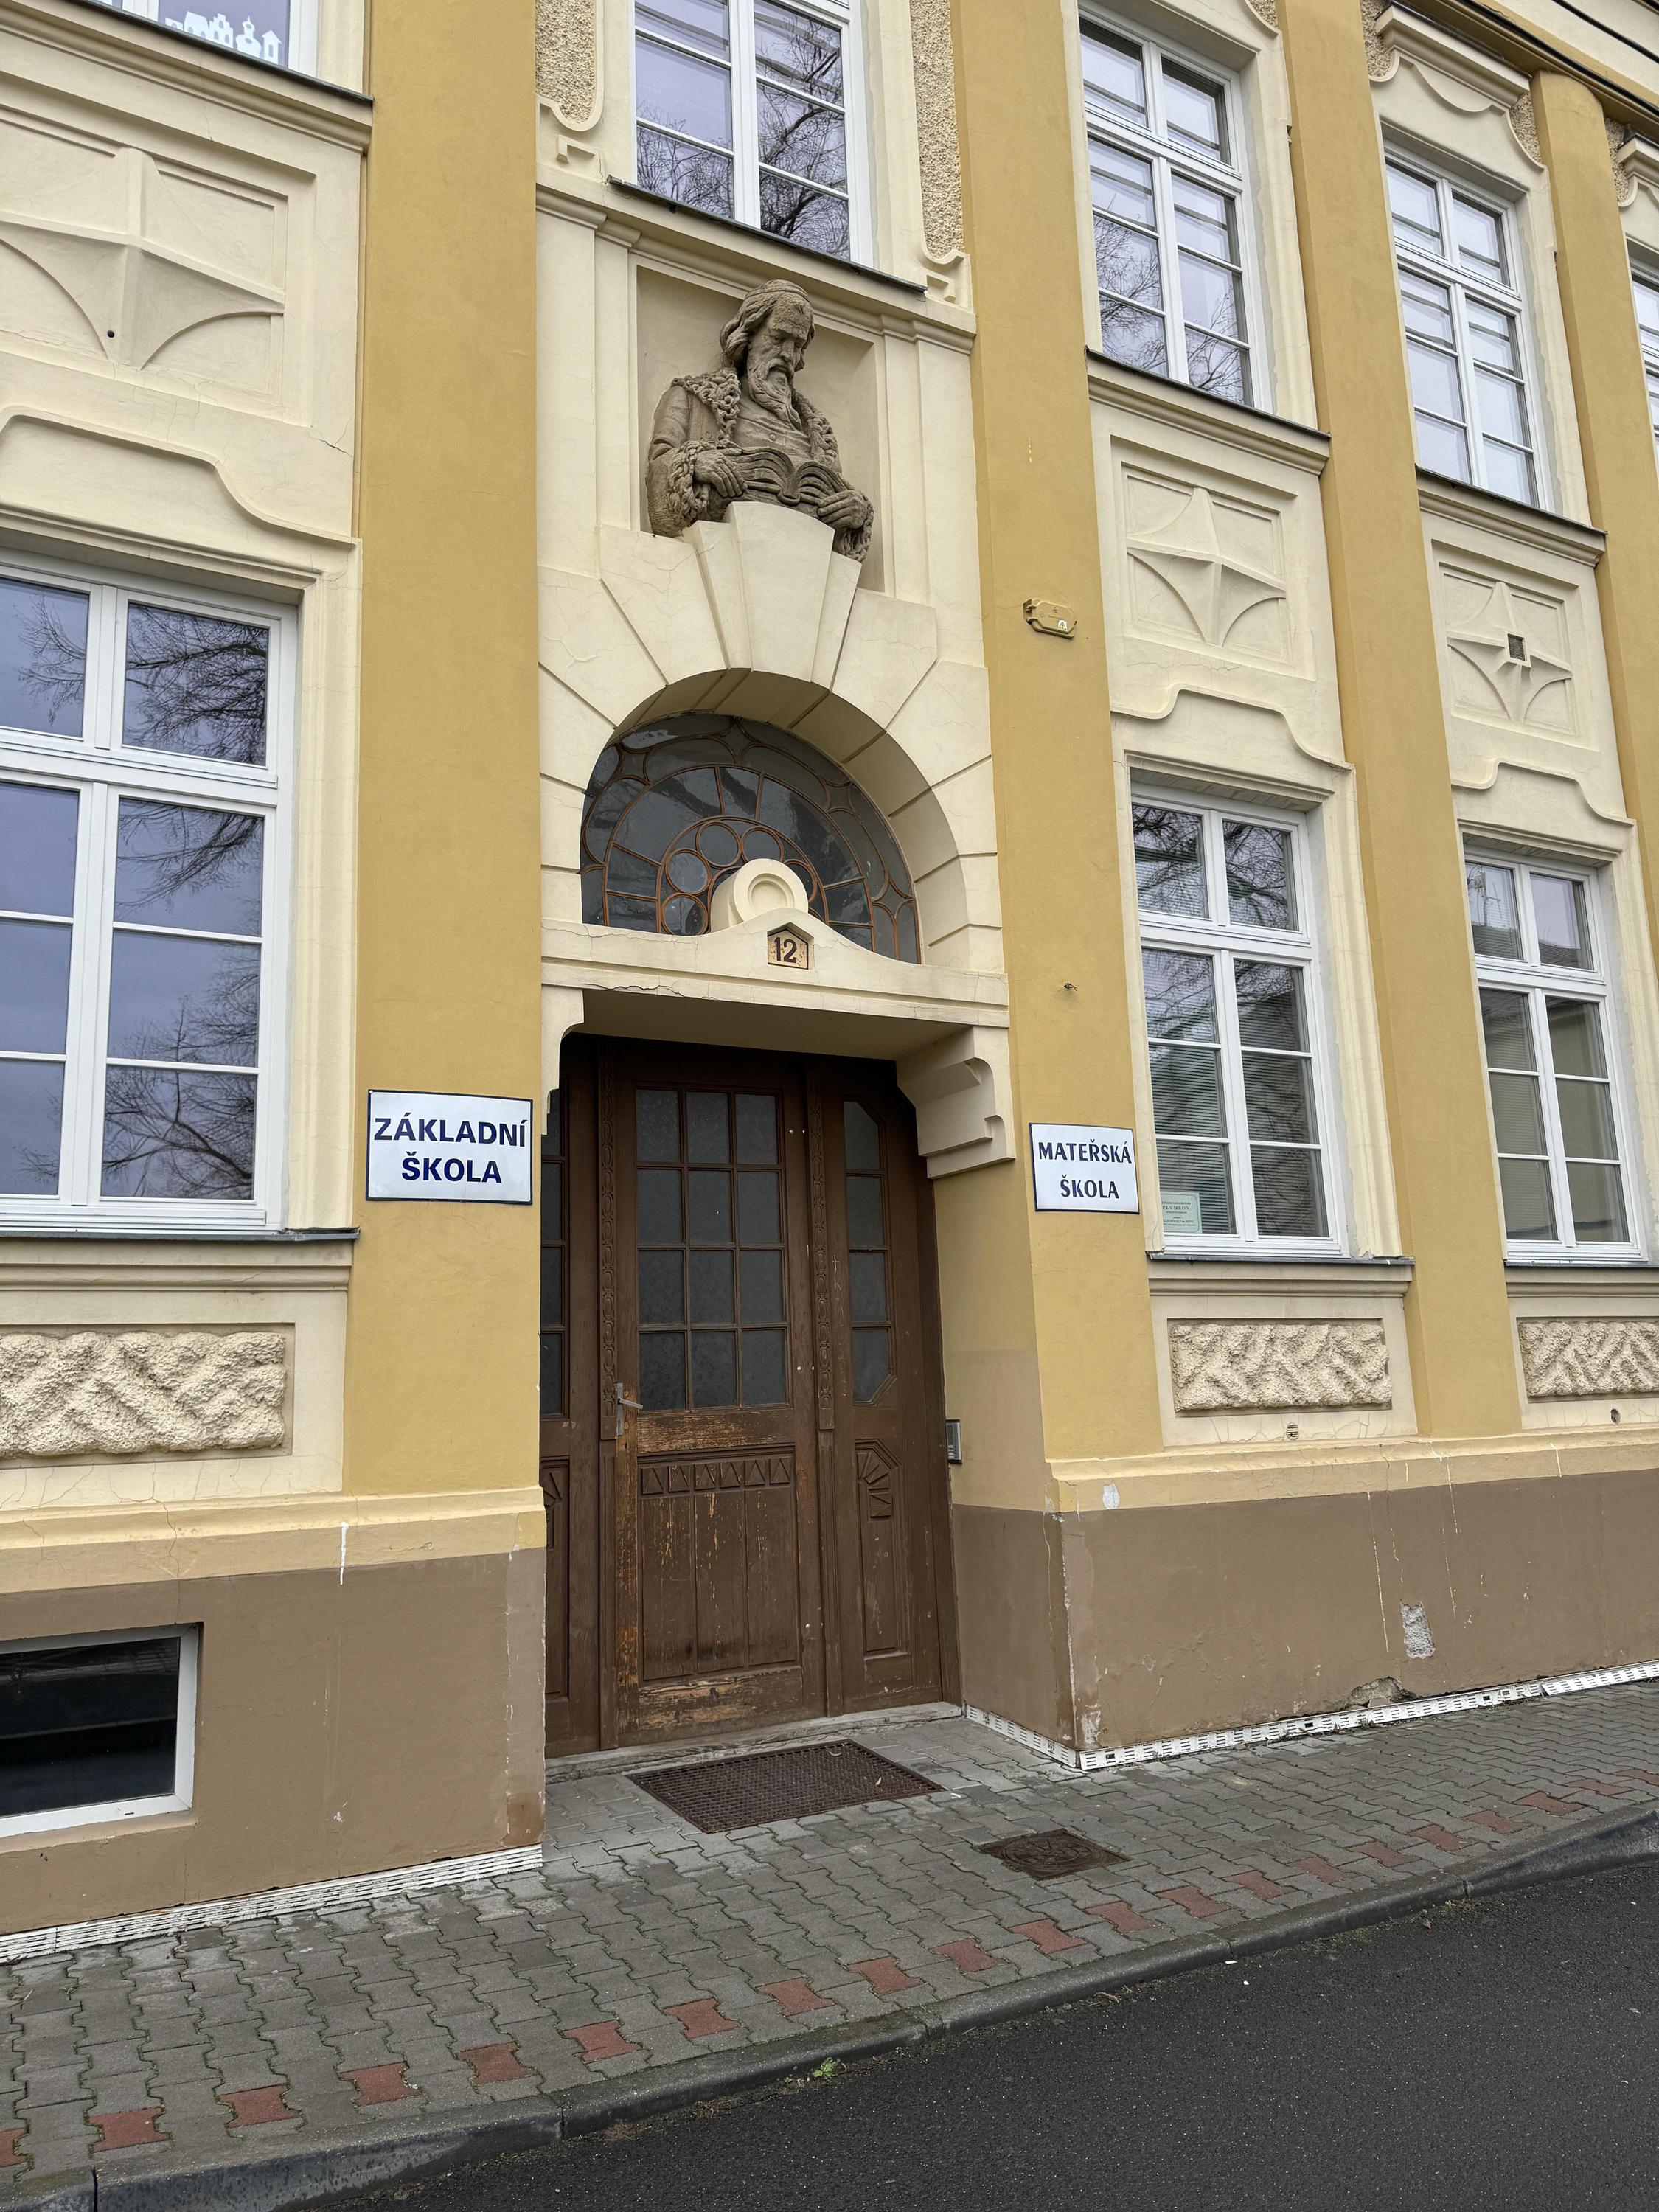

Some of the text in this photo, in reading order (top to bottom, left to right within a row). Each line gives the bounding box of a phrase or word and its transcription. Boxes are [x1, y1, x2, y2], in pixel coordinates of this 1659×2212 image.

[773, 936, 797, 964] 12
[373, 1111, 529, 1148] ZÁKLADNÍ
[1037, 1138, 1133, 1164] MATEŘSKÁ
[401, 1150, 503, 1184] ŠKOLA
[1060, 1173, 1120, 1200] ŠKOLA
